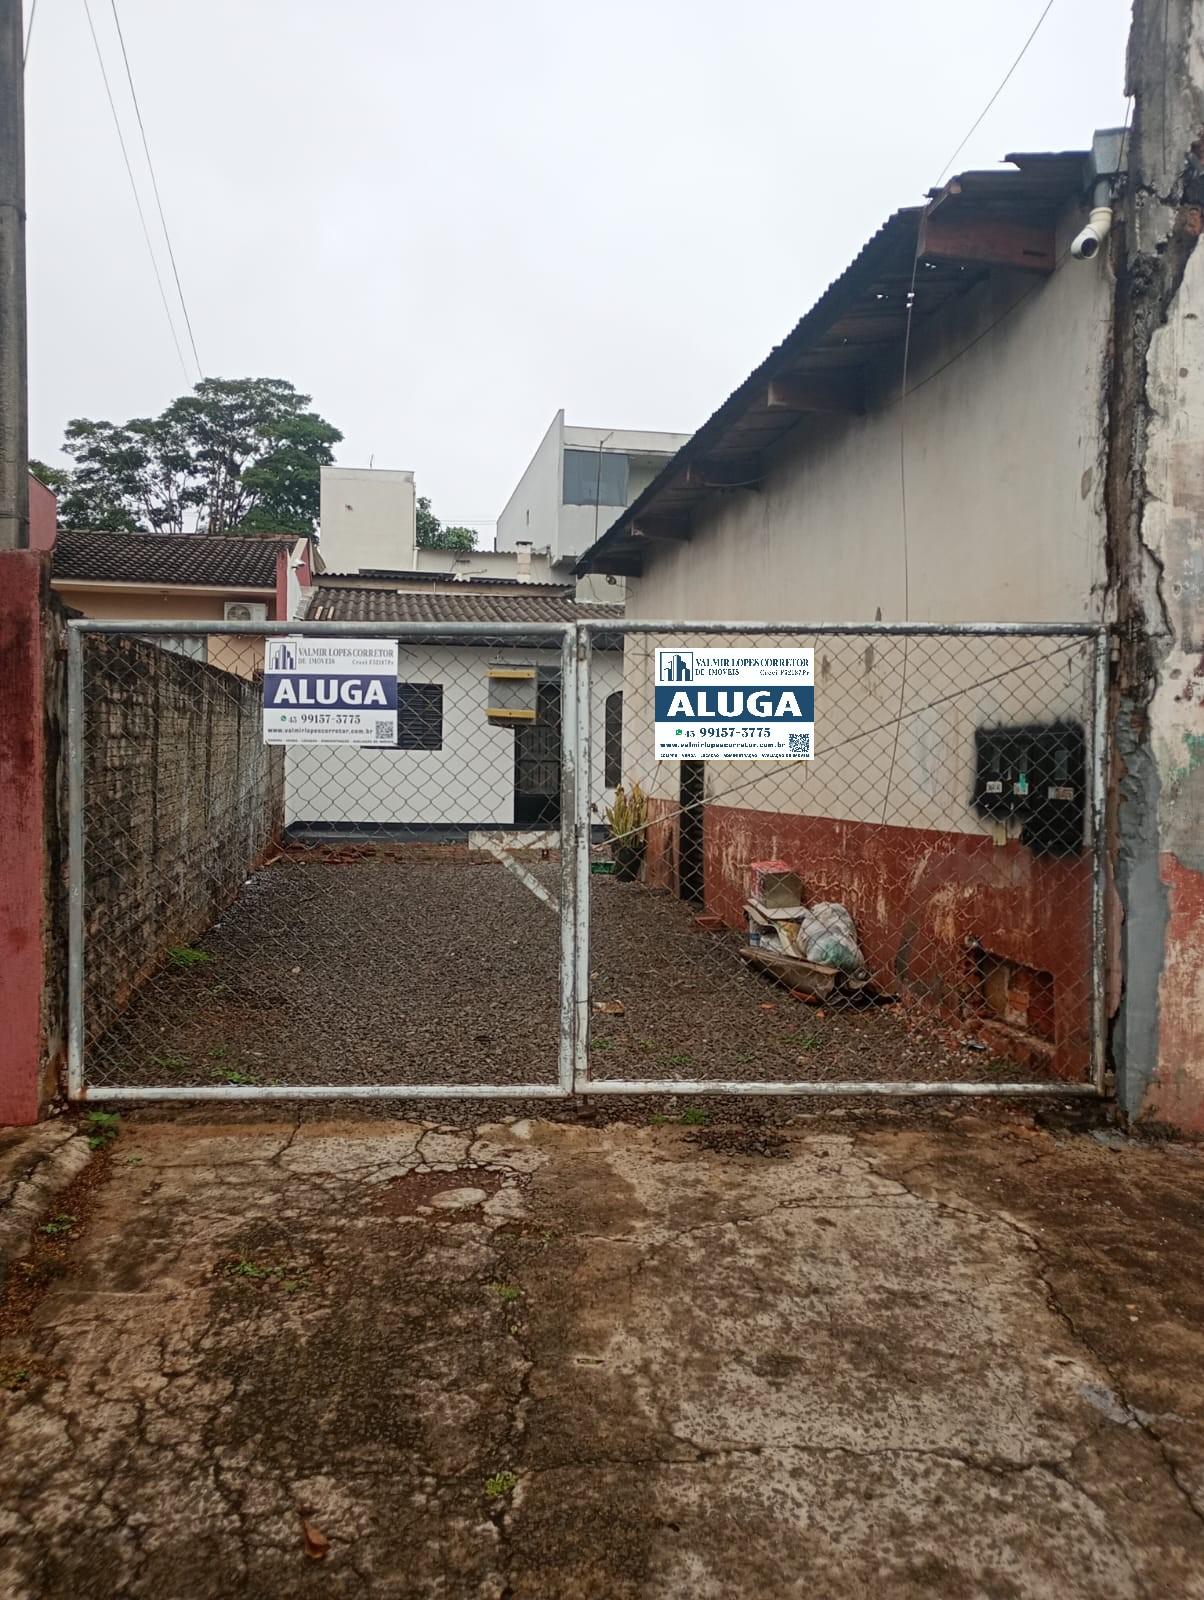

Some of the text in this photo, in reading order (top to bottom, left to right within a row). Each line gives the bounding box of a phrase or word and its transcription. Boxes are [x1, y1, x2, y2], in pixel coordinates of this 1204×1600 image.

[298, 647, 394, 658] VALMIR LOPES CORRETOR
[273, 678, 388, 705] ALUGA
[301, 714, 361, 725] 99157-3775
[267, 727, 373, 735] www.valmirlopescorretor.com.br
